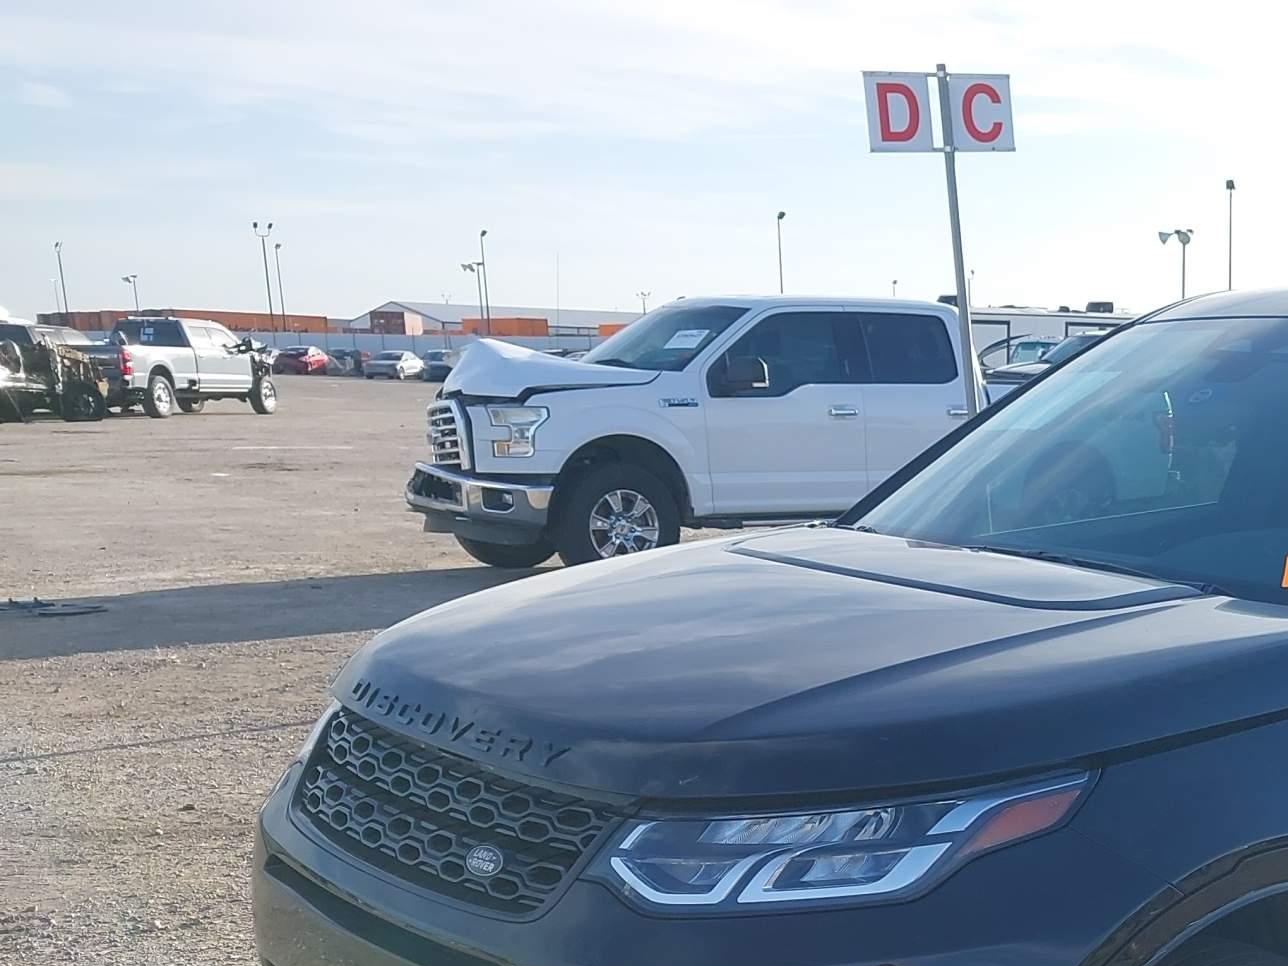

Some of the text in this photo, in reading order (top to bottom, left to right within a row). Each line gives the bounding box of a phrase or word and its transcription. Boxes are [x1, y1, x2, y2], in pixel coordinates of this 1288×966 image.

[876, 82, 1004, 143] D C
[351, 680, 571, 768] DISCOVERY
[472, 857, 496, 873] ROVER
[473, 848, 493, 860] LAND
